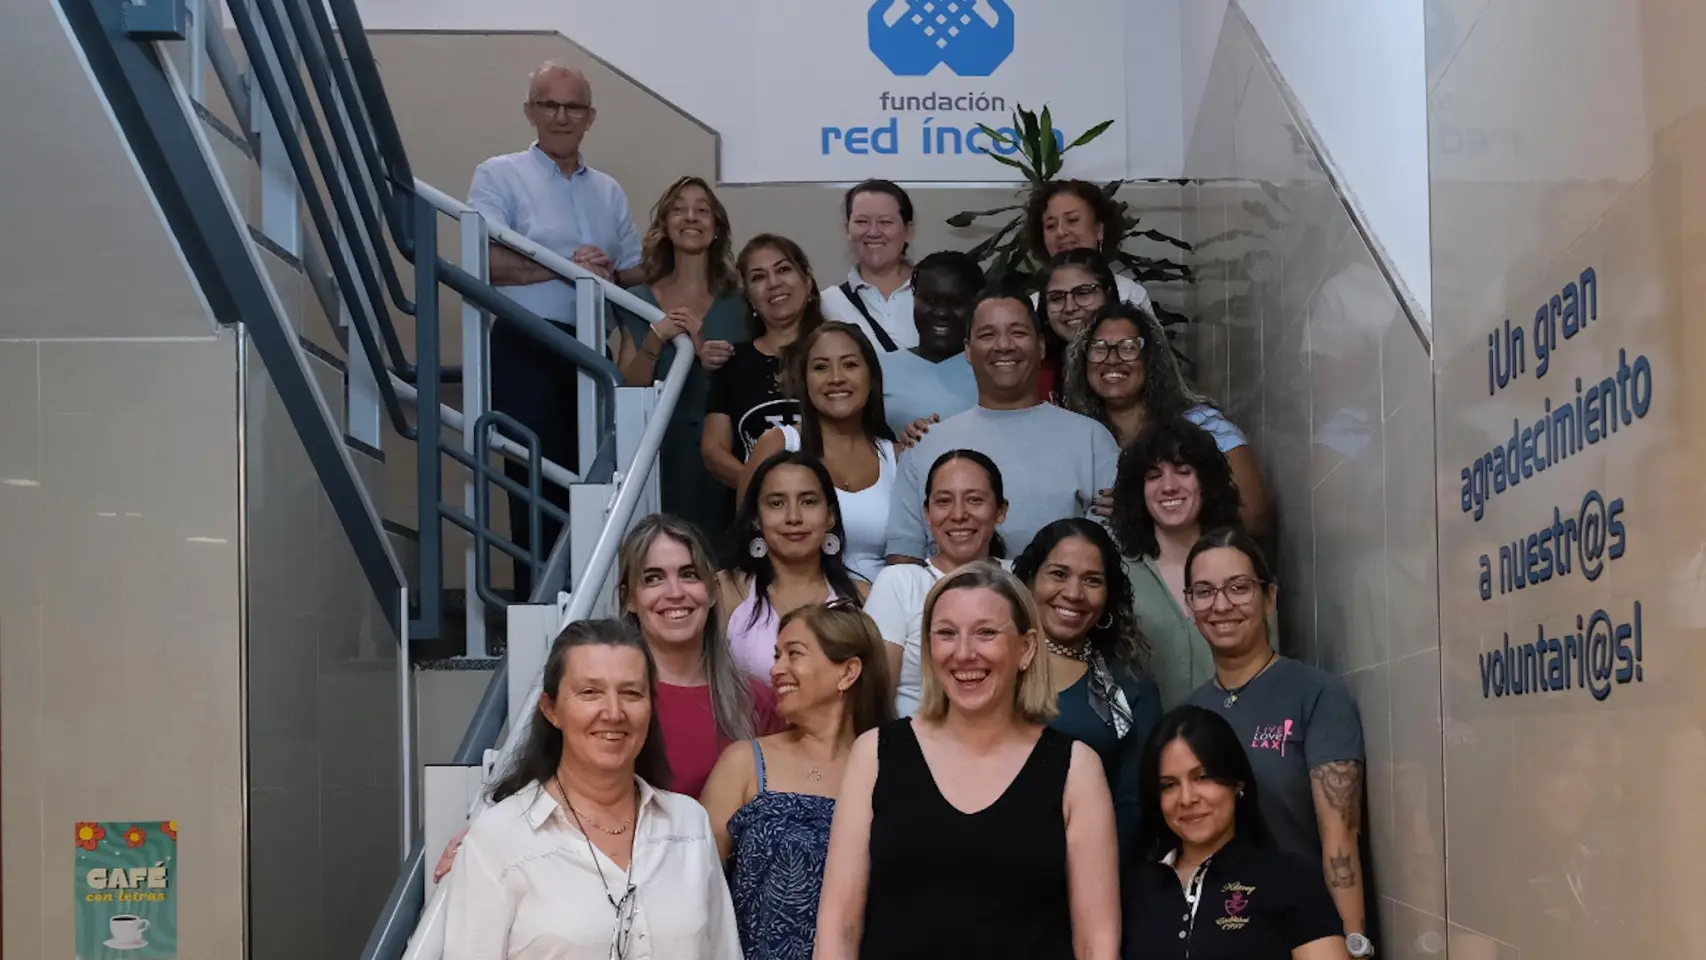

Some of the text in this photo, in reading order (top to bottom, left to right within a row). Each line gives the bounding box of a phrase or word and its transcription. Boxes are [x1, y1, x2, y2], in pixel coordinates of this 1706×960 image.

[821, 117, 1064, 156] red ínco
[880, 91, 1005, 112] fundación
[1533, 266, 1597, 379] gran
[1460, 347, 1652, 521] agradecimiento
[1479, 490, 1626, 601] a nuestr@s
[1478, 600, 1643, 701] voluntari@s!
[86, 889, 166, 902] con letras
[87, 861, 169, 889] CAFÉ
